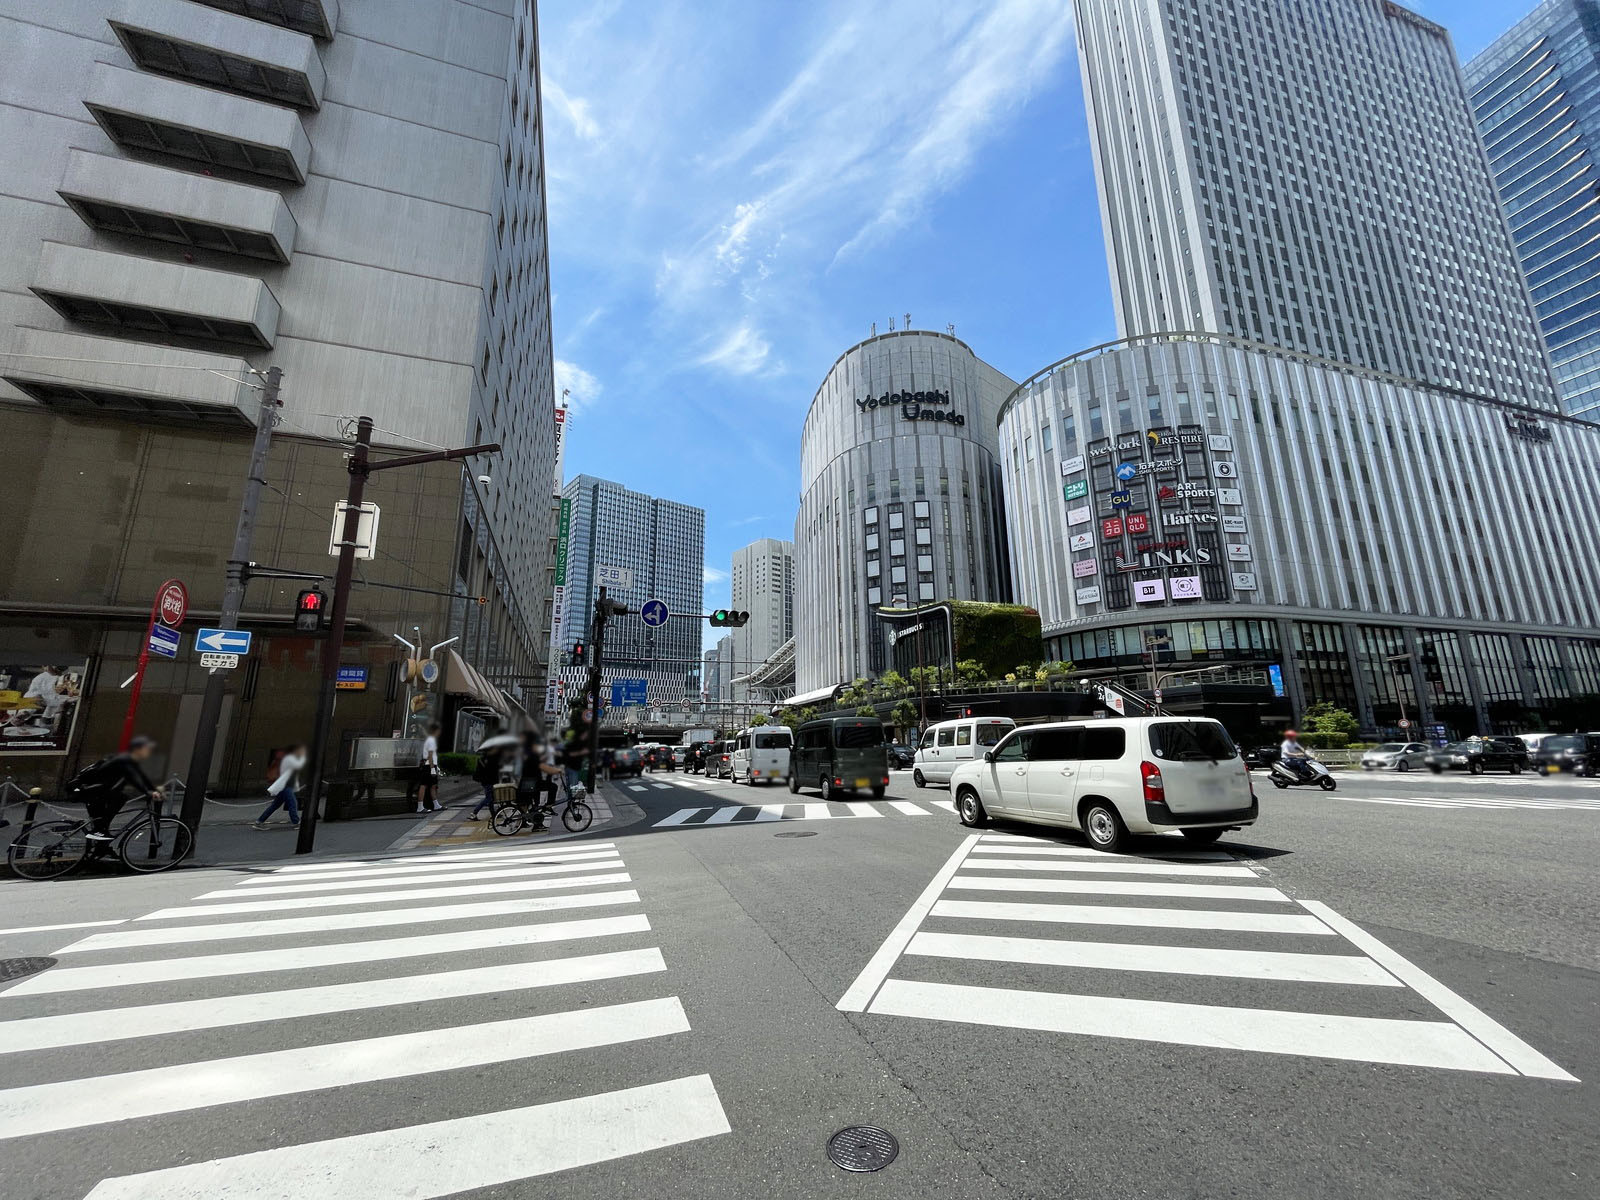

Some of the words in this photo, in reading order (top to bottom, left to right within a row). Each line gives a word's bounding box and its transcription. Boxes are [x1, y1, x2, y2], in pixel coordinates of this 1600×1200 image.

[856, 389, 950, 412] Yodobashi
[902, 403, 965, 426] Umeda
[1161, 434, 1204, 445] RESPIRE
[1089, 437, 1142, 457] wework
[1067, 481, 1084, 494] ニトリ
[1177, 482, 1197, 491] ART
[1112, 494, 1130, 505] GU
[1177, 489, 1215, 499] SPORTS
[1128, 516, 1143, 524] UNI
[1162, 513, 1218, 526] Harves
[1129, 522, 1145, 532] QLO
[1114, 548, 1211, 571] LINKS
[599, 567, 620, 580] 芝田
[624, 571, 628, 581] 1
[163, 595, 182, 615] 消火栓
[201, 660, 236, 668] ここから
